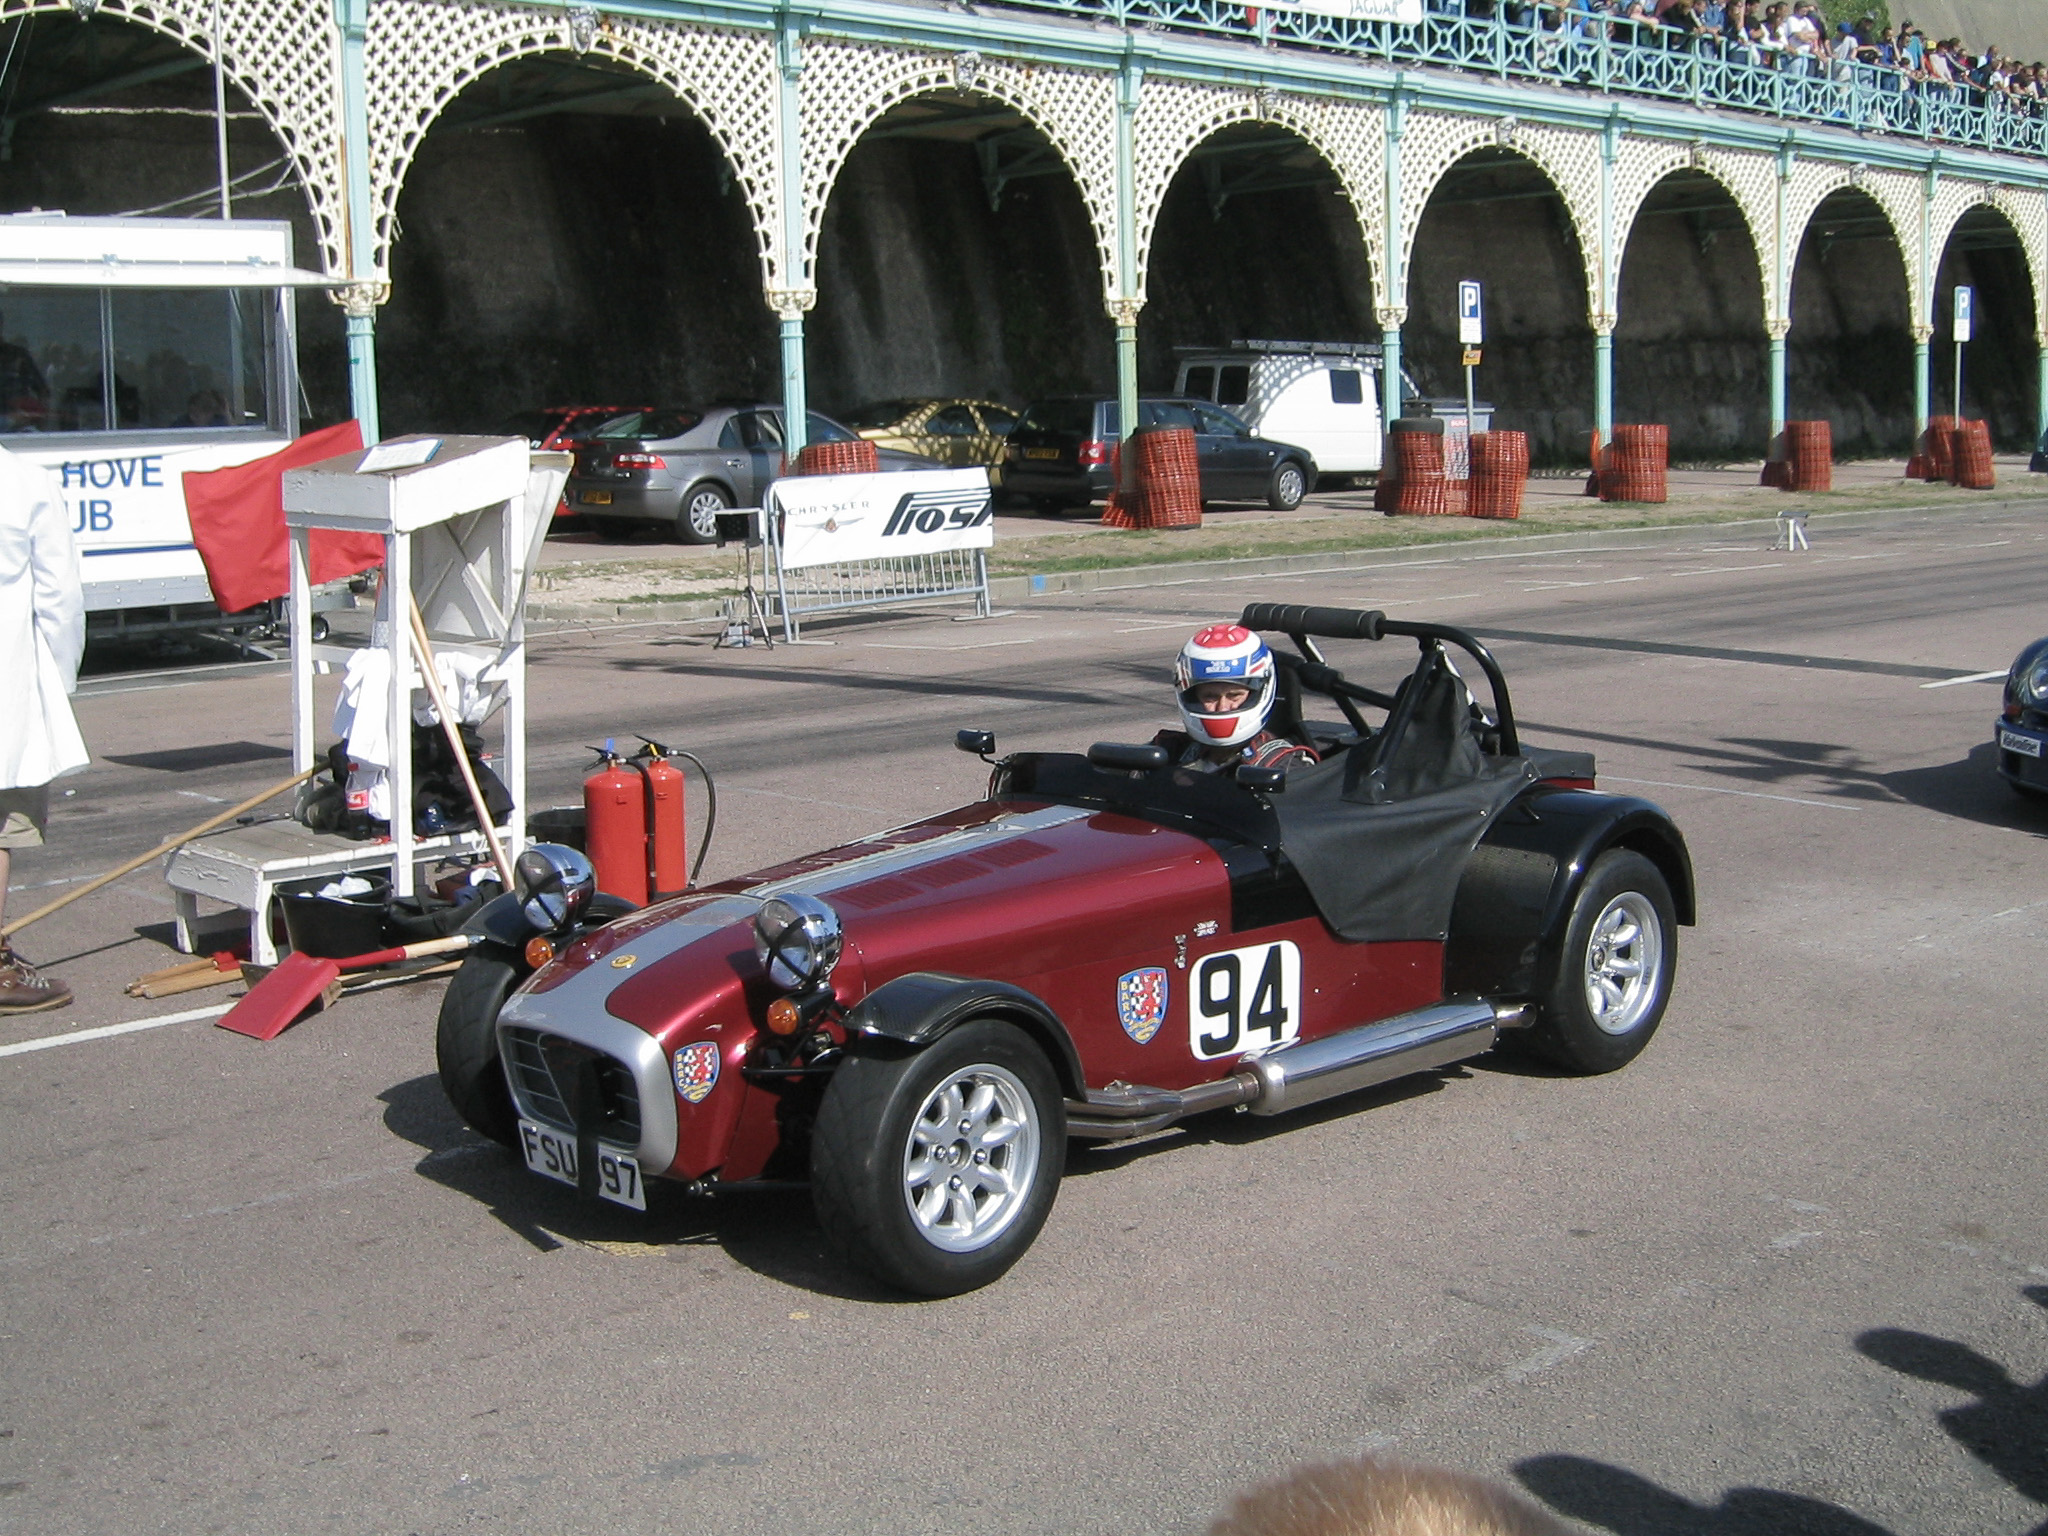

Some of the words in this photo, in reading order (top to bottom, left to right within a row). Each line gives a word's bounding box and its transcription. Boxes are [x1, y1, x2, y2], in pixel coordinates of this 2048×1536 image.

[1349, 0, 1398, 16] JAGUAR
[1464, 287, 1477, 317] P
[1958, 293, 1969, 318] P
[61, 455, 164, 489] HOVE
[787, 500, 870, 516] CHRYSLER
[1120, 981, 1132, 1023] BARC
[1199, 944, 1289, 1057] 94
[522, 1127, 578, 1179] FSU
[600, 1155, 637, 1200] 97
